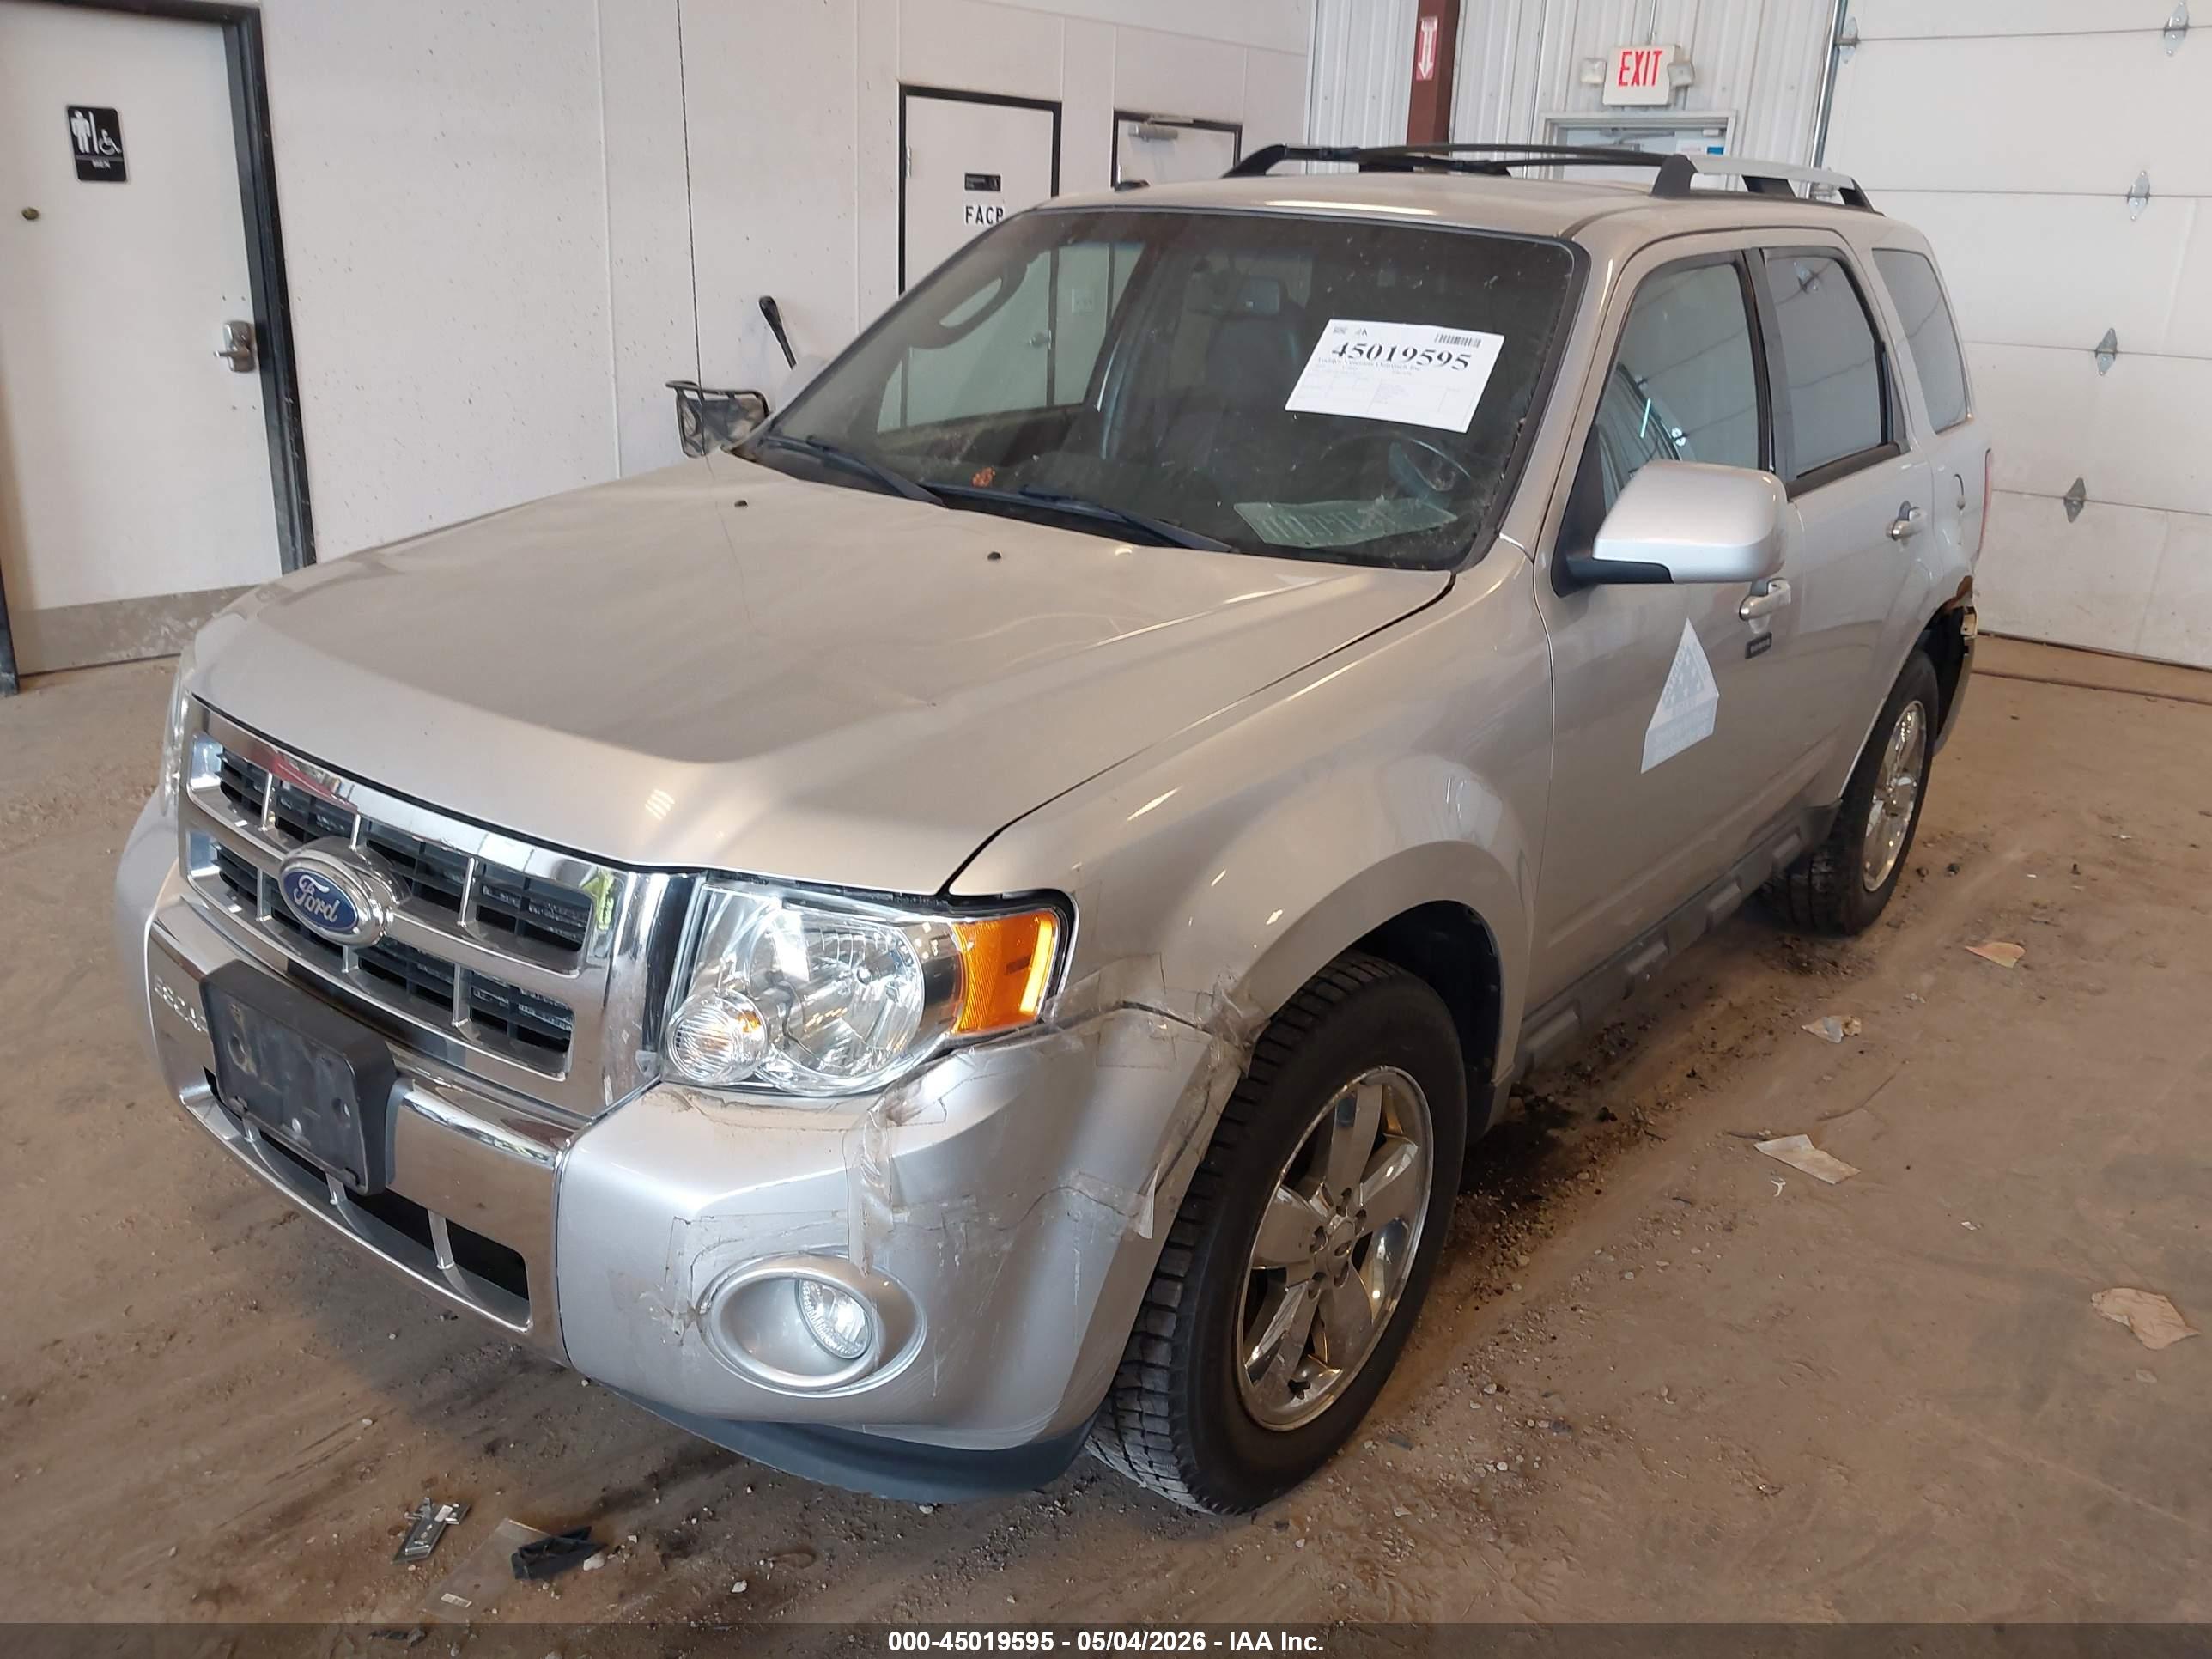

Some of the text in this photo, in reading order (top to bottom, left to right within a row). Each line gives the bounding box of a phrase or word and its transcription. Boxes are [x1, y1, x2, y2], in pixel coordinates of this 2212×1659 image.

[1619, 50, 1662, 86] EXIT
[1332, 341, 1472, 371] 45019595
[293, 874, 340, 923] Ford
